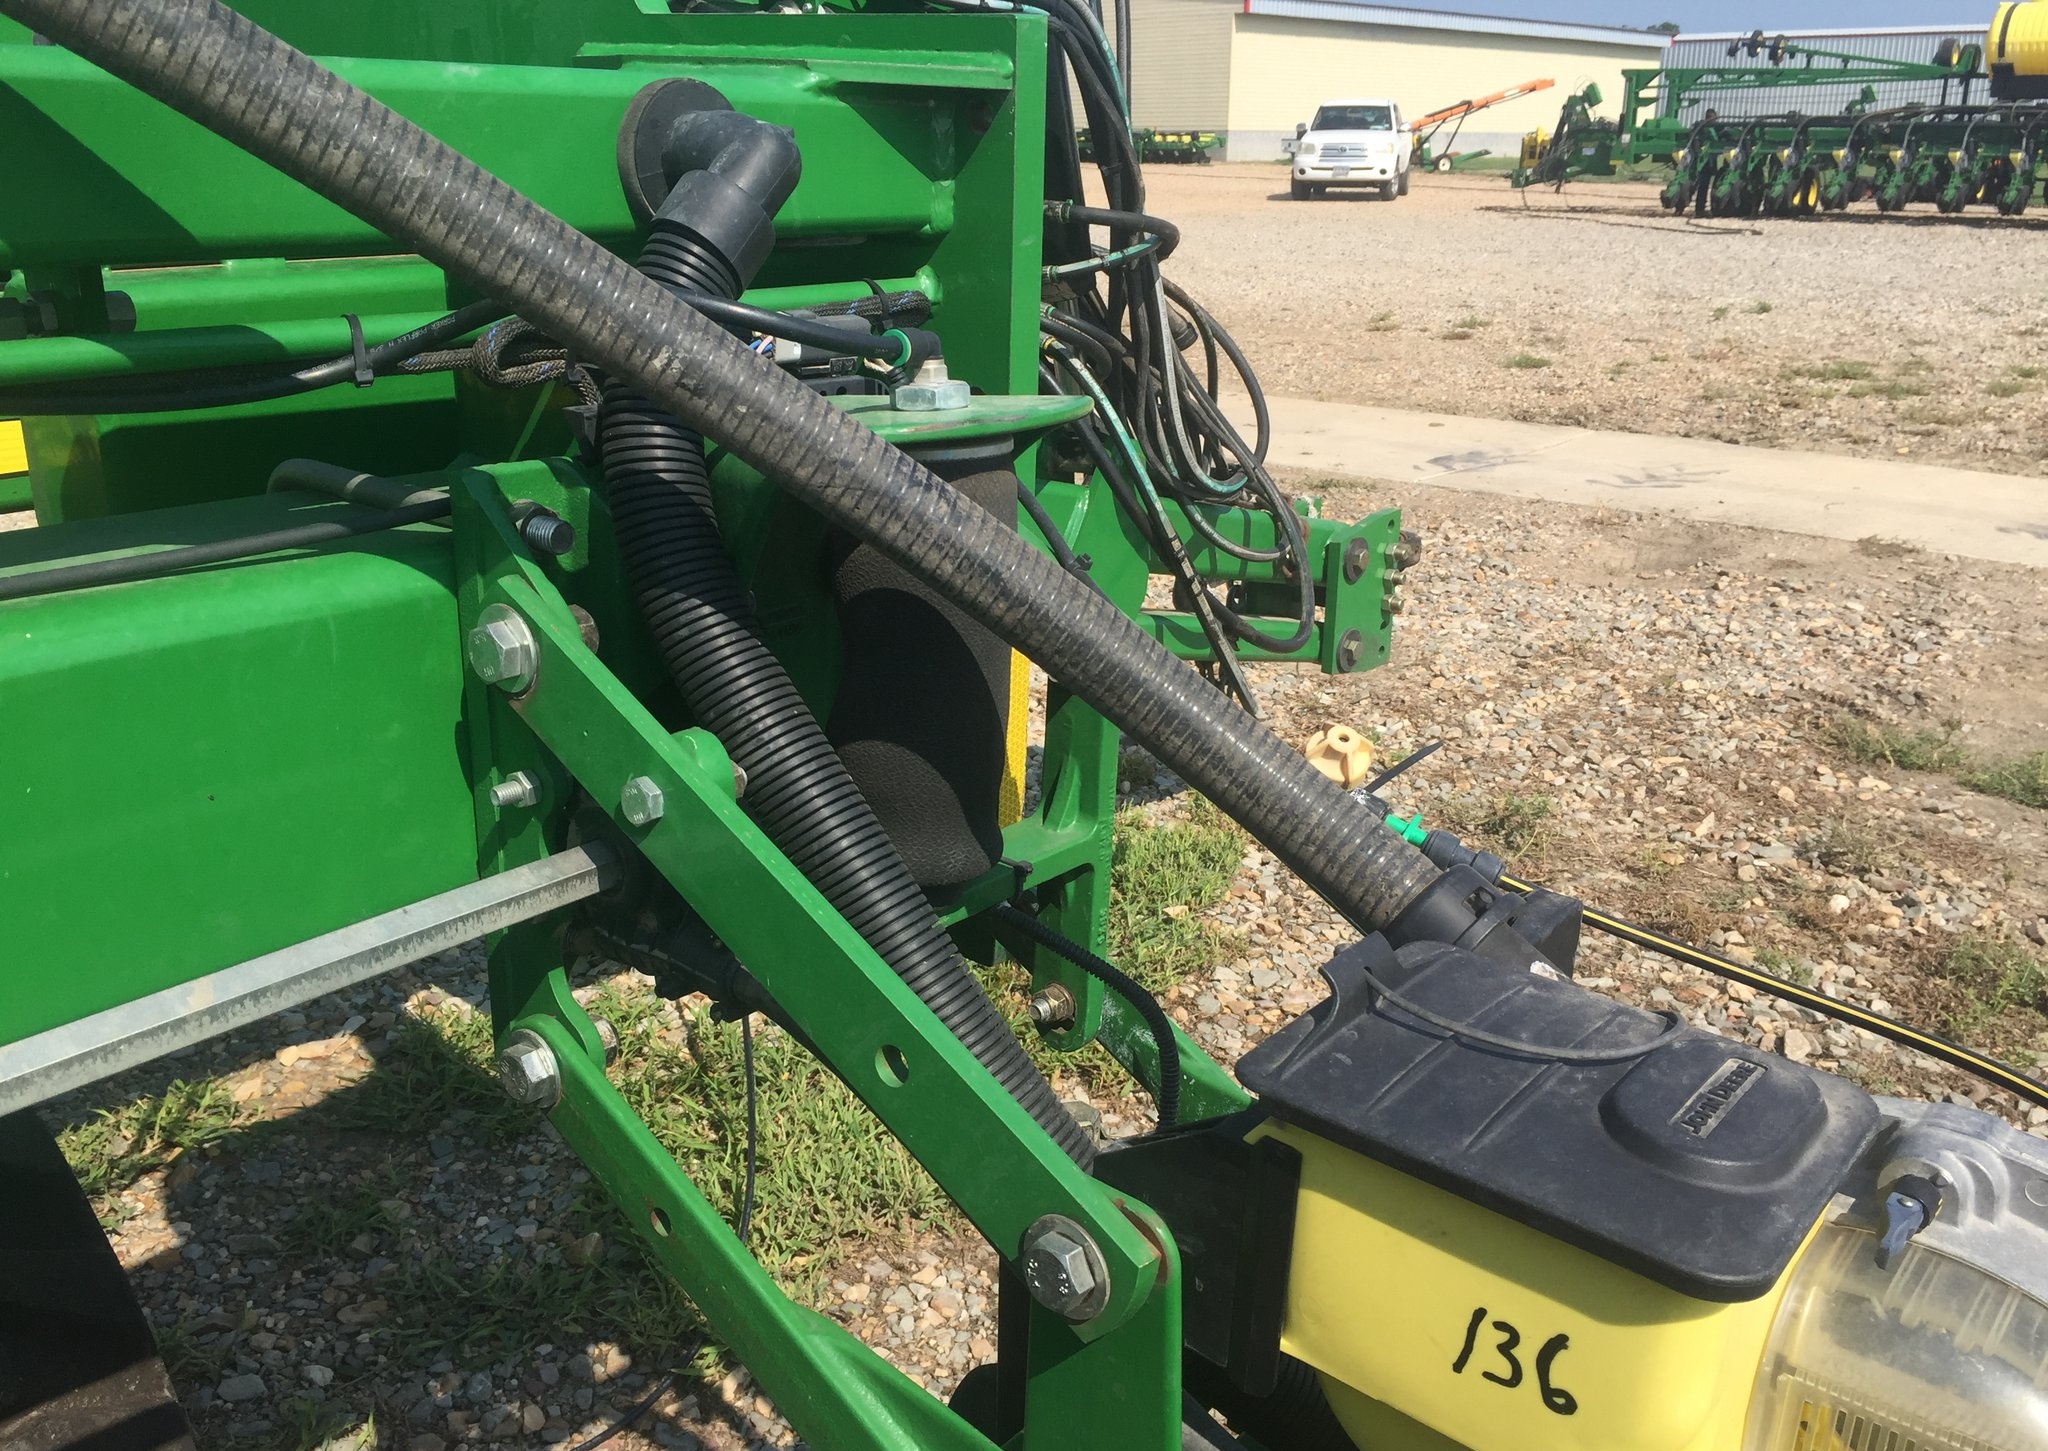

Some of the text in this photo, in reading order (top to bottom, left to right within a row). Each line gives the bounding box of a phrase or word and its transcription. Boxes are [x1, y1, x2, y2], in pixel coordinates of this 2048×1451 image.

[1680, 1062, 1759, 1135] JOHN DEERE
[1453, 1307, 1578, 1416] 136
